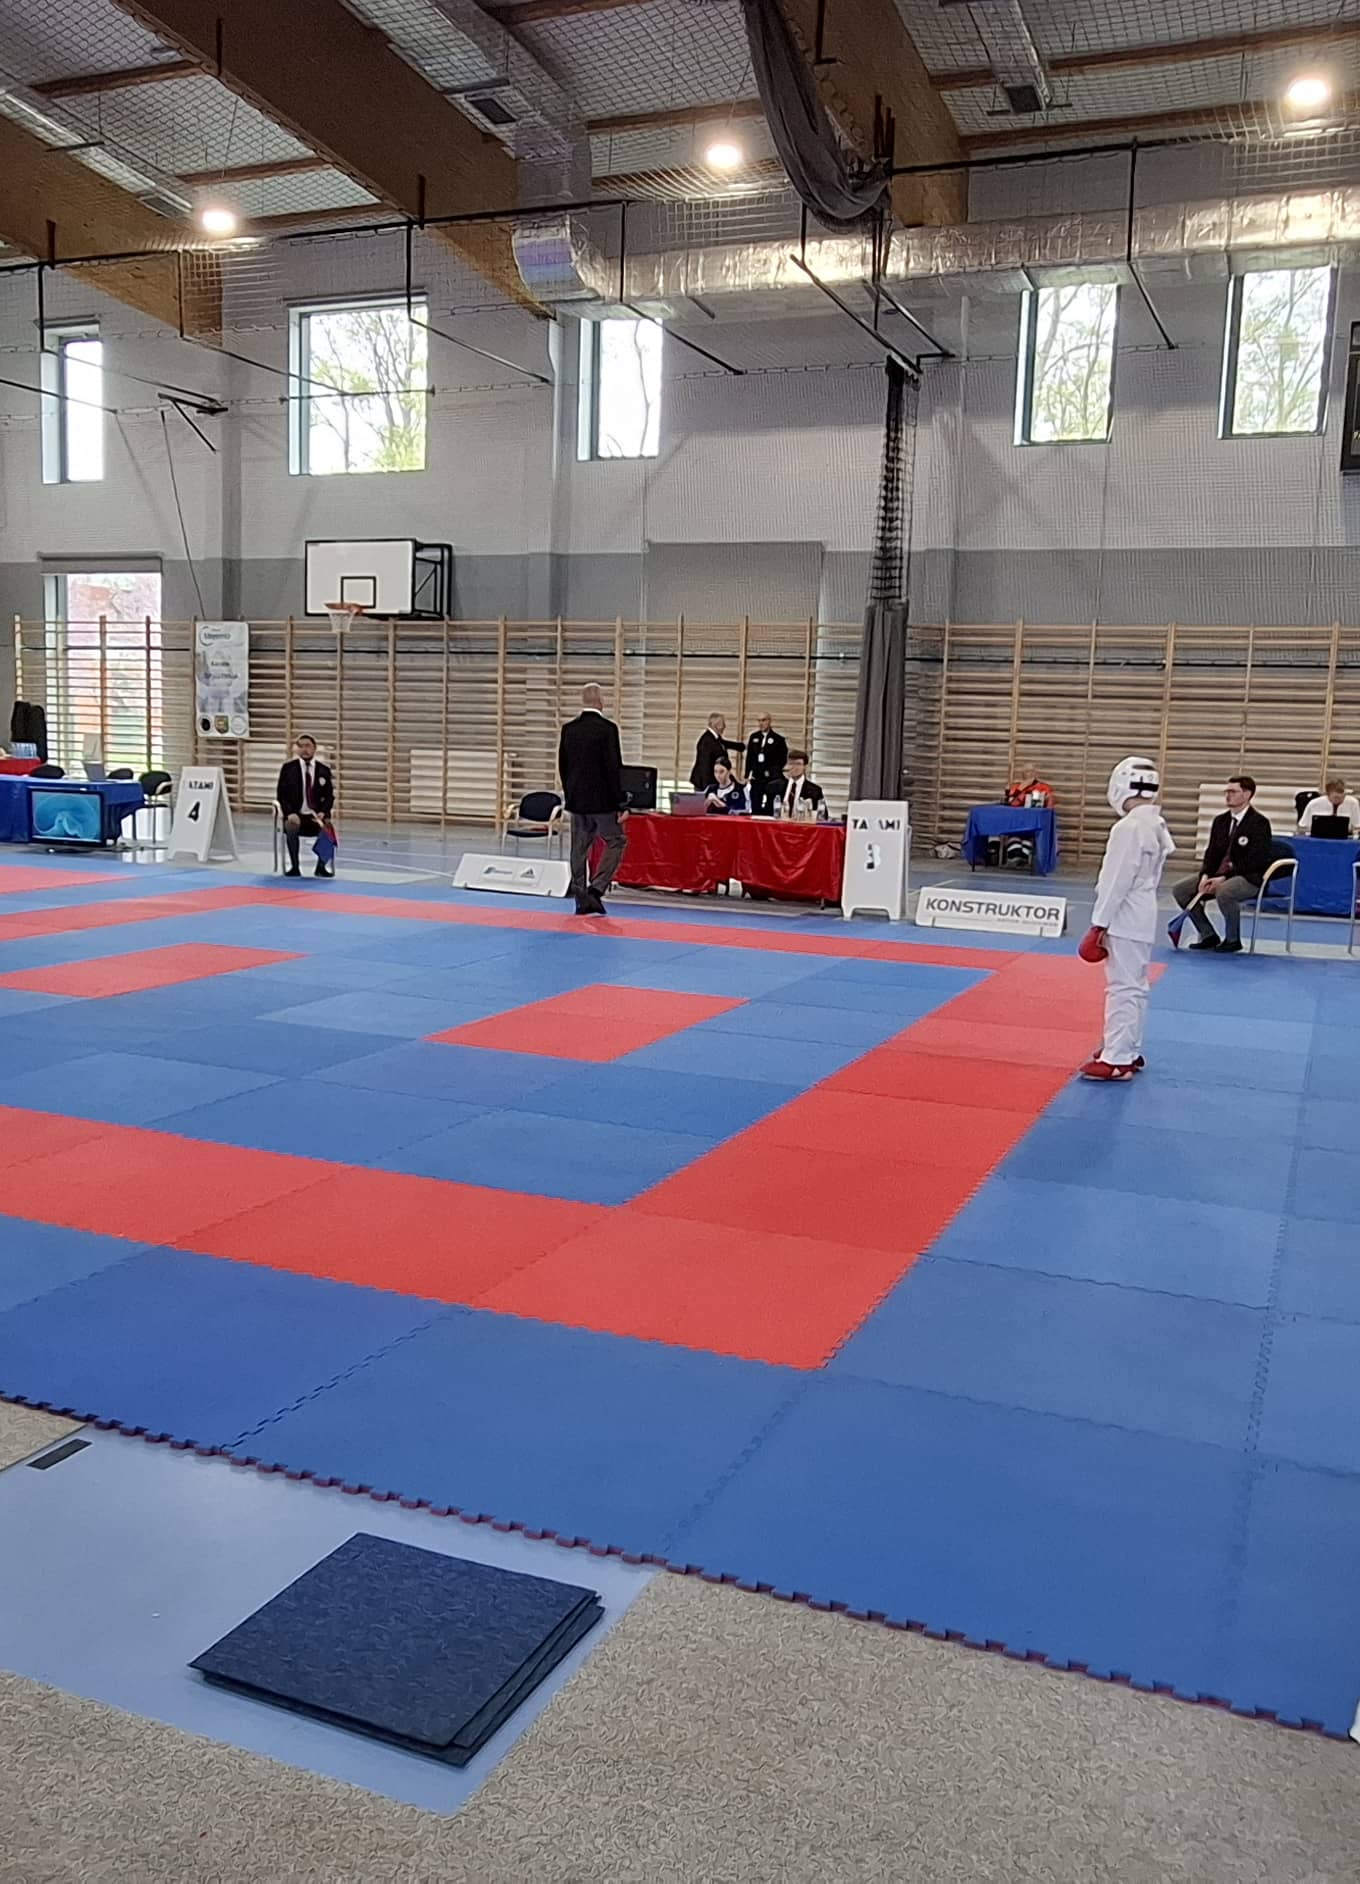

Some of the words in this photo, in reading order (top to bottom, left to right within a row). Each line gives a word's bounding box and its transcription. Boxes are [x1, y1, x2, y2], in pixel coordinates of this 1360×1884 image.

[188, 802, 200, 821] 4
[852, 819, 900, 830] TAMI
[926, 897, 1061, 921] KONSTRUKTOR
